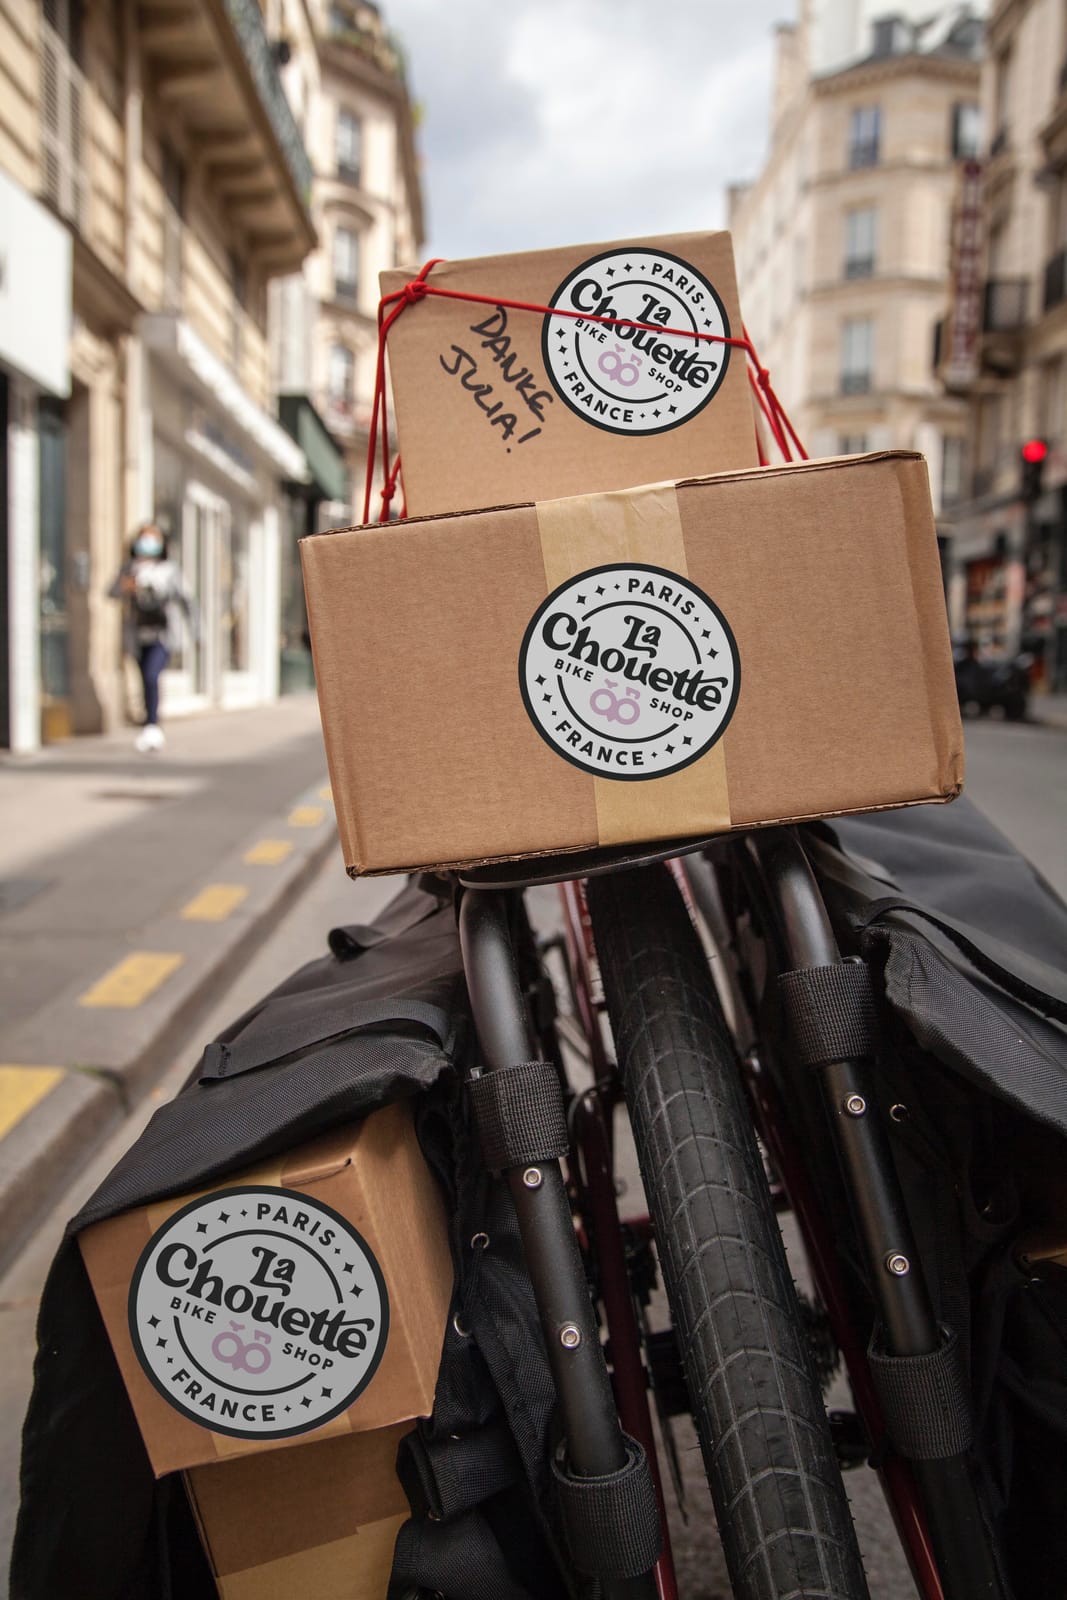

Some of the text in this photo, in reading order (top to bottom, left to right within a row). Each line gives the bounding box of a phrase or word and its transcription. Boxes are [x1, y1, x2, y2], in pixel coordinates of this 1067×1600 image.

[651, 262, 704, 305] PARIS
[570, 278, 718, 389] Chouette
[641, 293, 672, 334] La
[470, 305, 554, 423] DANKE
[574, 318, 683, 394] BIKE SHOP
[439, 344, 542, 454] JULIA!
[563, 371, 634, 423] FRANCE
[628, 578, 696, 616] PARIS
[541, 612, 729, 712] Chouette
[621, 615, 662, 659] La
[554, 658, 694, 722] BIKE SHOP
[555, 720, 644, 766] FRANCE
[257, 1203, 336, 1246] PARIS
[249, 1246, 296, 1297] La
[155, 1242, 375, 1359] Chouette
[170, 1296, 334, 1370] BIKE SHOP
[171, 1368, 276, 1422] FRANCE
